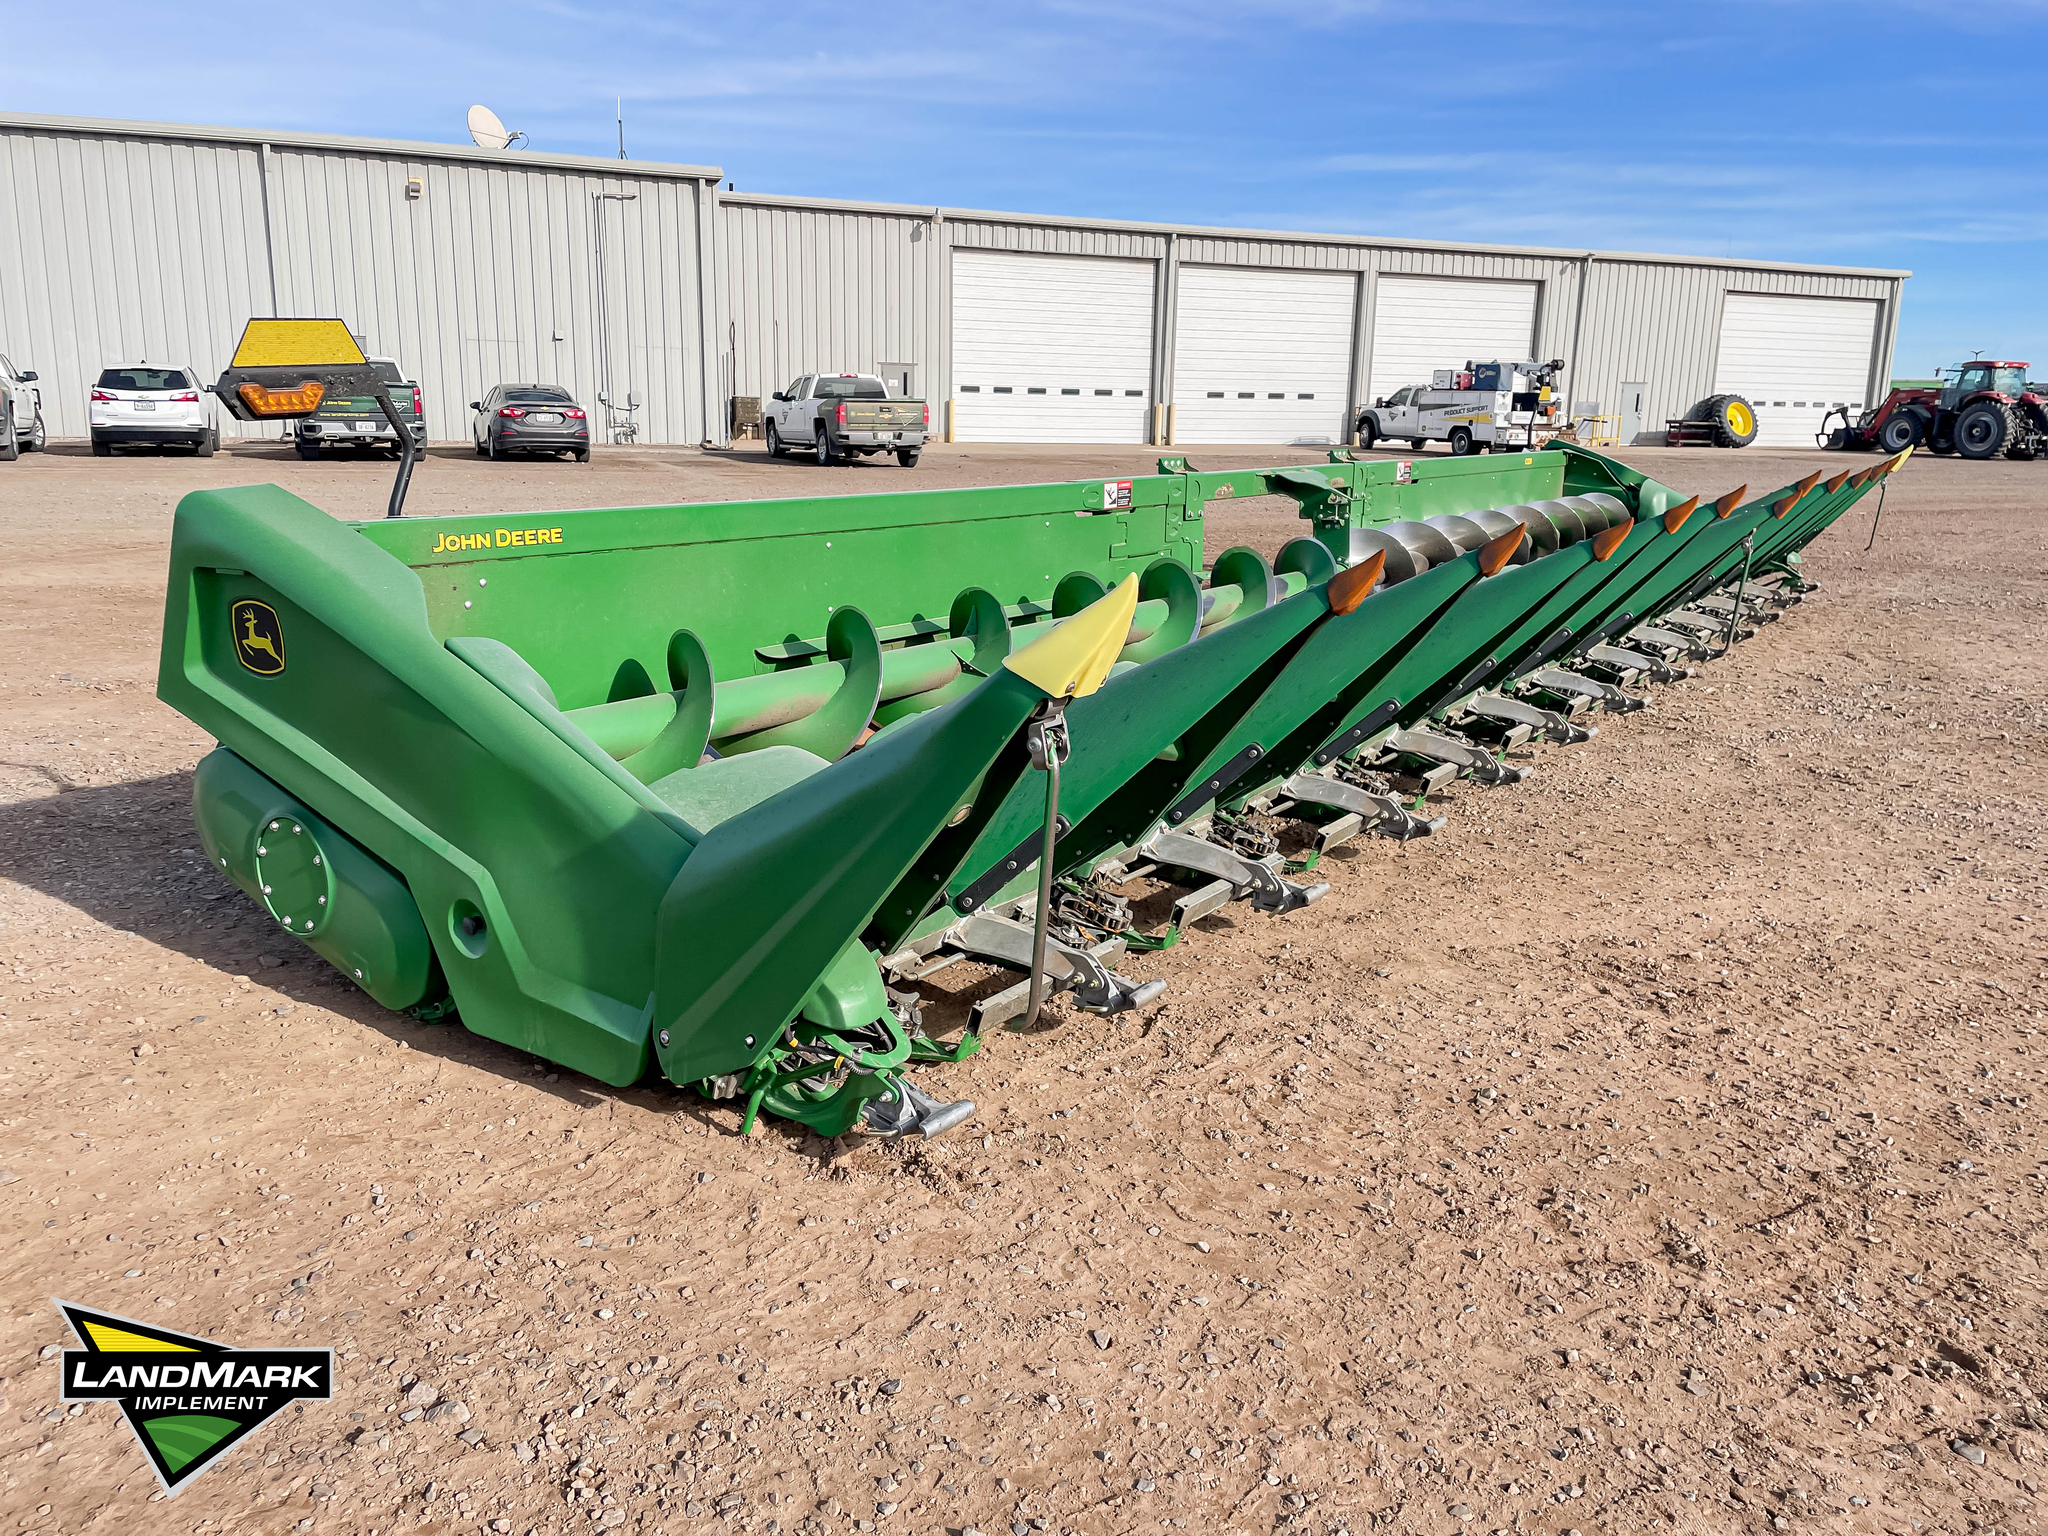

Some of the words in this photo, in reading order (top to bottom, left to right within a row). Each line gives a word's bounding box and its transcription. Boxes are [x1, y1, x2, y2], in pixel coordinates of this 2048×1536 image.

[1443, 407, 1466, 417] PRODUCT
[1466, 404, 1489, 414] SUPPORT
[432, 532, 491, 553] JOHN
[495, 528, 563, 548] DEERE
